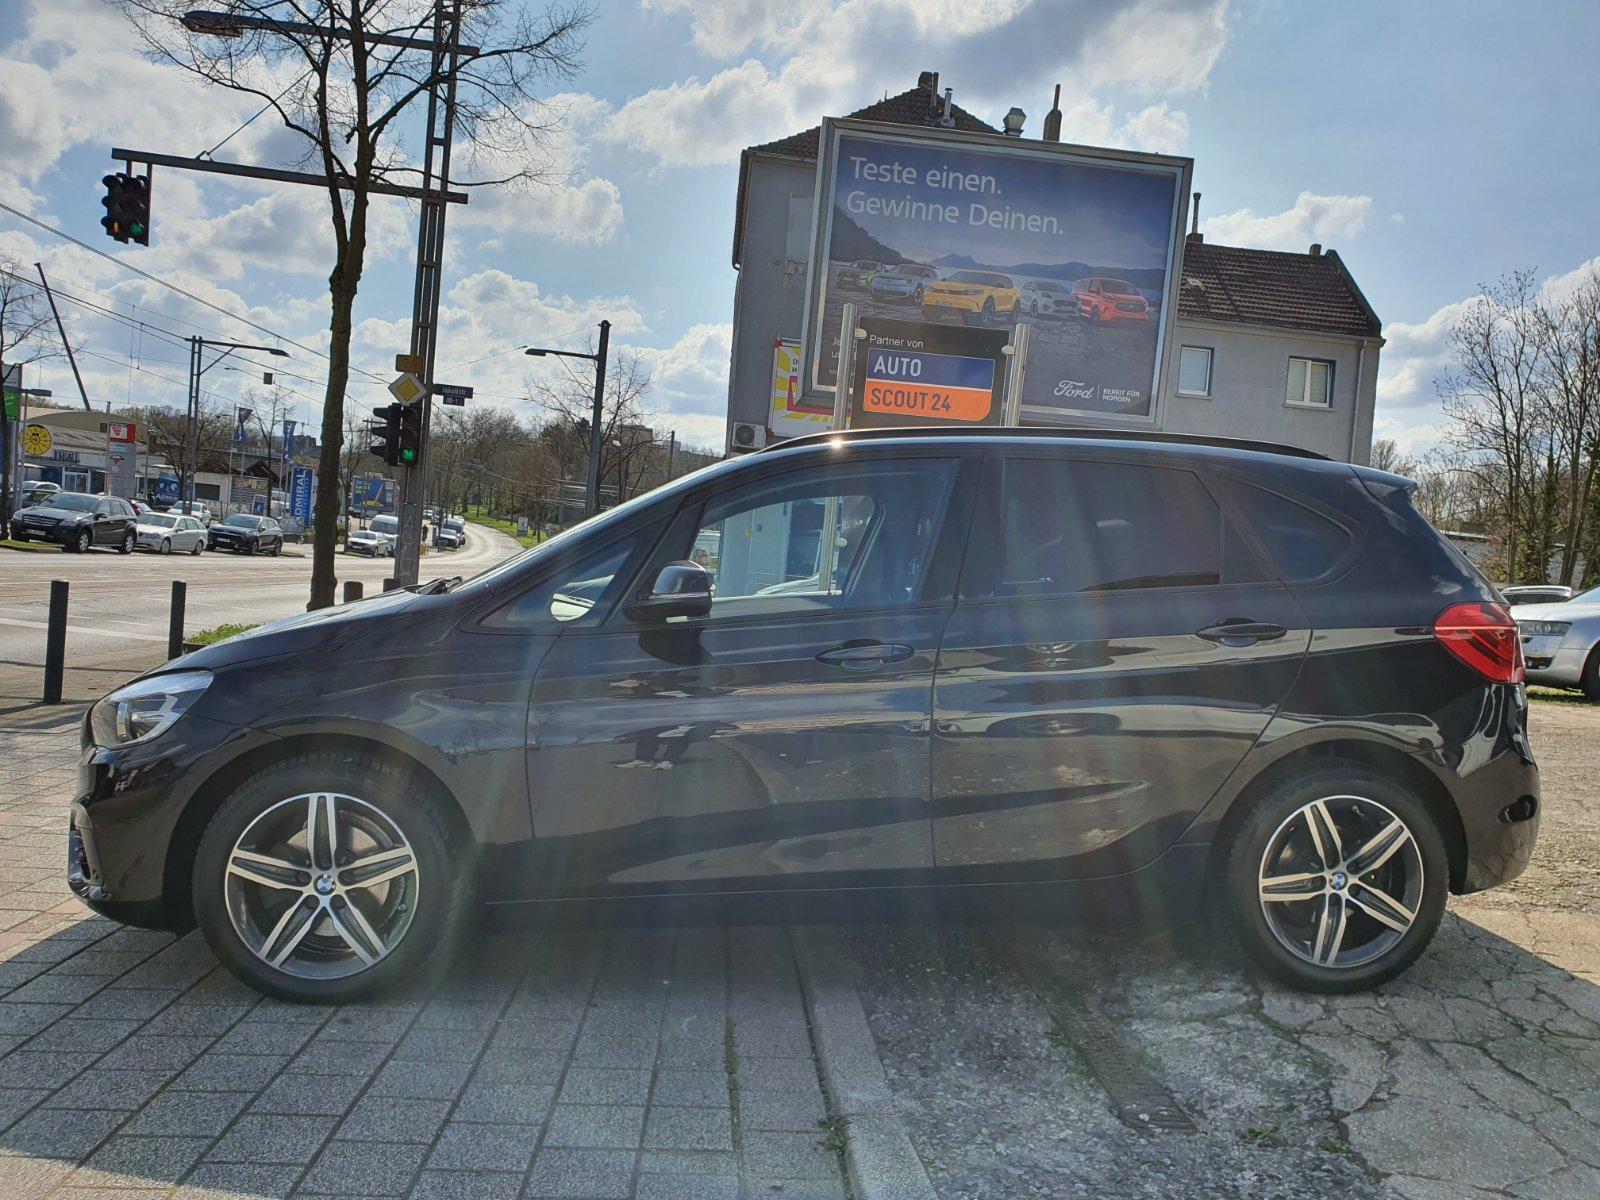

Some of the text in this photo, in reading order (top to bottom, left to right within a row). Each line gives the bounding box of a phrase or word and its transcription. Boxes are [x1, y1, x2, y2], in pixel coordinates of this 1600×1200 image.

[849, 156, 1002, 195] Teste einen.
[846, 190, 1064, 235] Gewinne Deinen.
[869, 334, 924, 348] Partner von
[873, 355, 922, 377] AUTO
[1053, 380, 1095, 399] Ford
[1102, 395, 1131, 403] MORGEN
[1103, 388, 1140, 398] BEREIT FÜR
